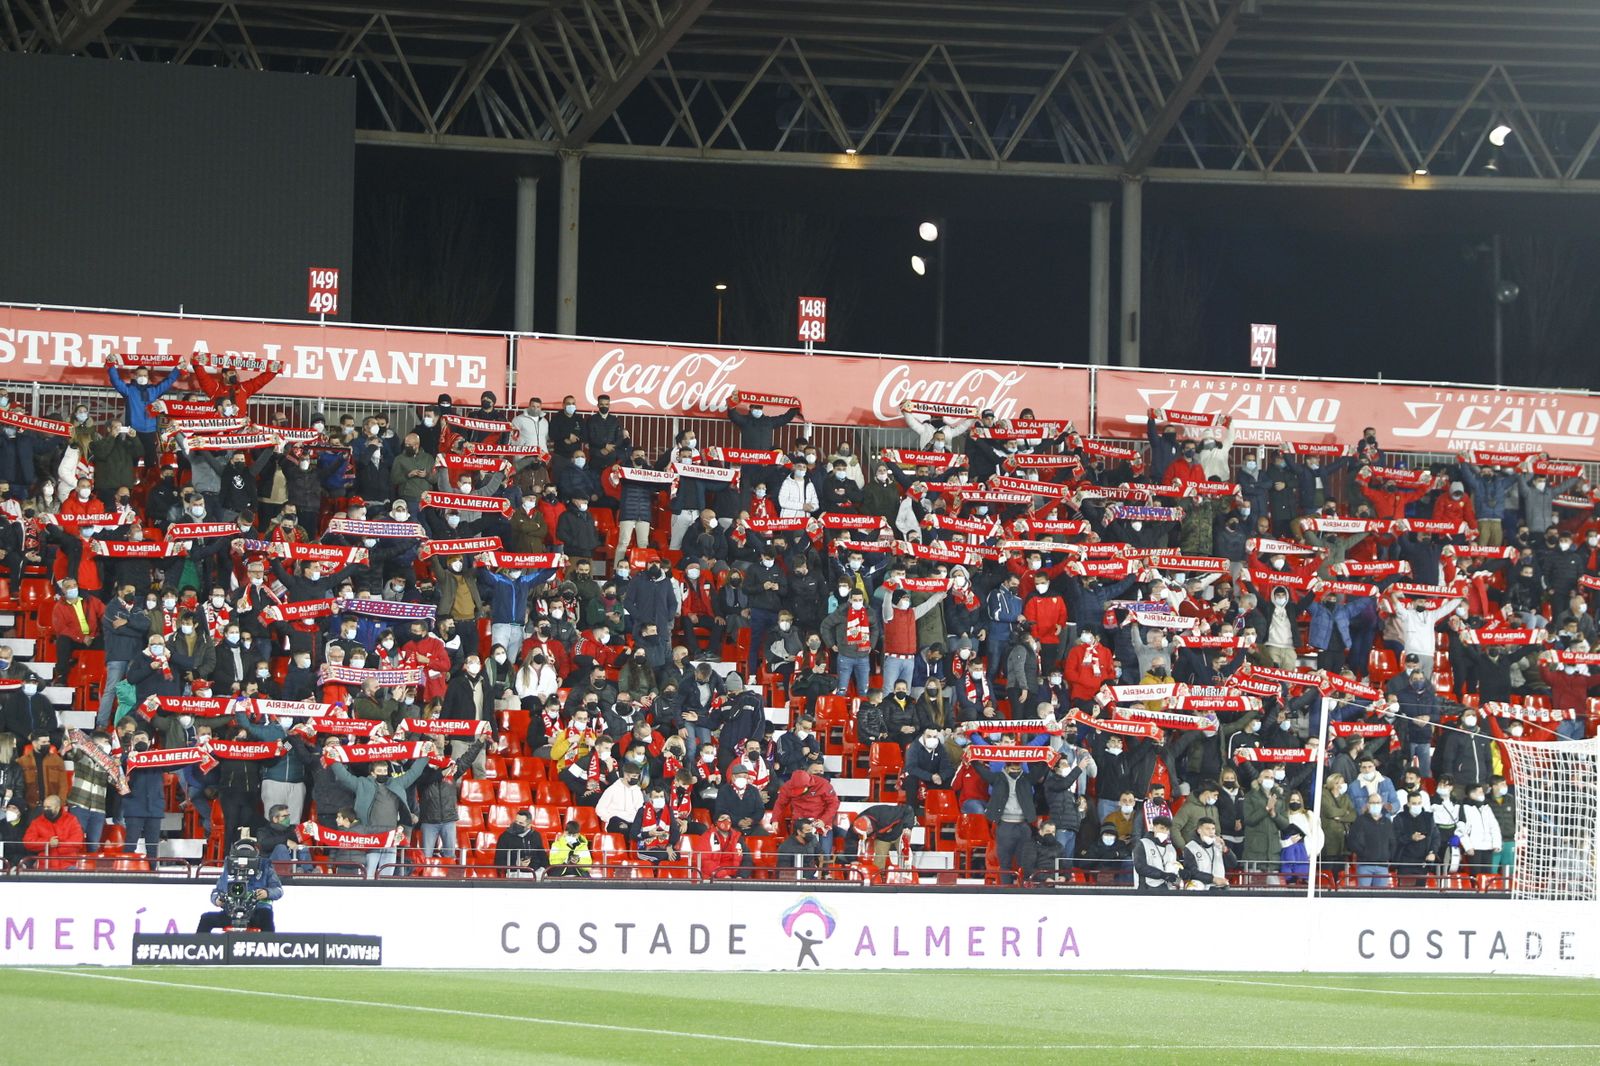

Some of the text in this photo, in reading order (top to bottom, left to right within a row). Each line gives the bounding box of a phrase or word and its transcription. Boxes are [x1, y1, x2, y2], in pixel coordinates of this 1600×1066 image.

[311, 271, 333, 289] 149
[310, 292, 333, 312] 49
[800, 300, 821, 317] 148
[800, 320, 821, 339] 48
[1252, 327, 1272, 344] 147
[1252, 347, 1272, 366] 47
[263, 343, 487, 389] LEVANTE
[585, 348, 748, 412] Coca-Cola
[1170, 379, 1297, 394] TRANSPORTES
[873, 364, 1027, 421] Coca-Cola
[1435, 392, 1558, 407] TRANSPORTES
[1234, 429, 1282, 441] ALMERIA
[1447, 439, 1544, 452] ANTAS ALMERIA
[854, 916, 1081, 957] ALMERÍA
[136, 943, 224, 961] #FANCAM
[233, 941, 320, 959] #FANCAM
[326, 943, 380, 961] #FANCAM
